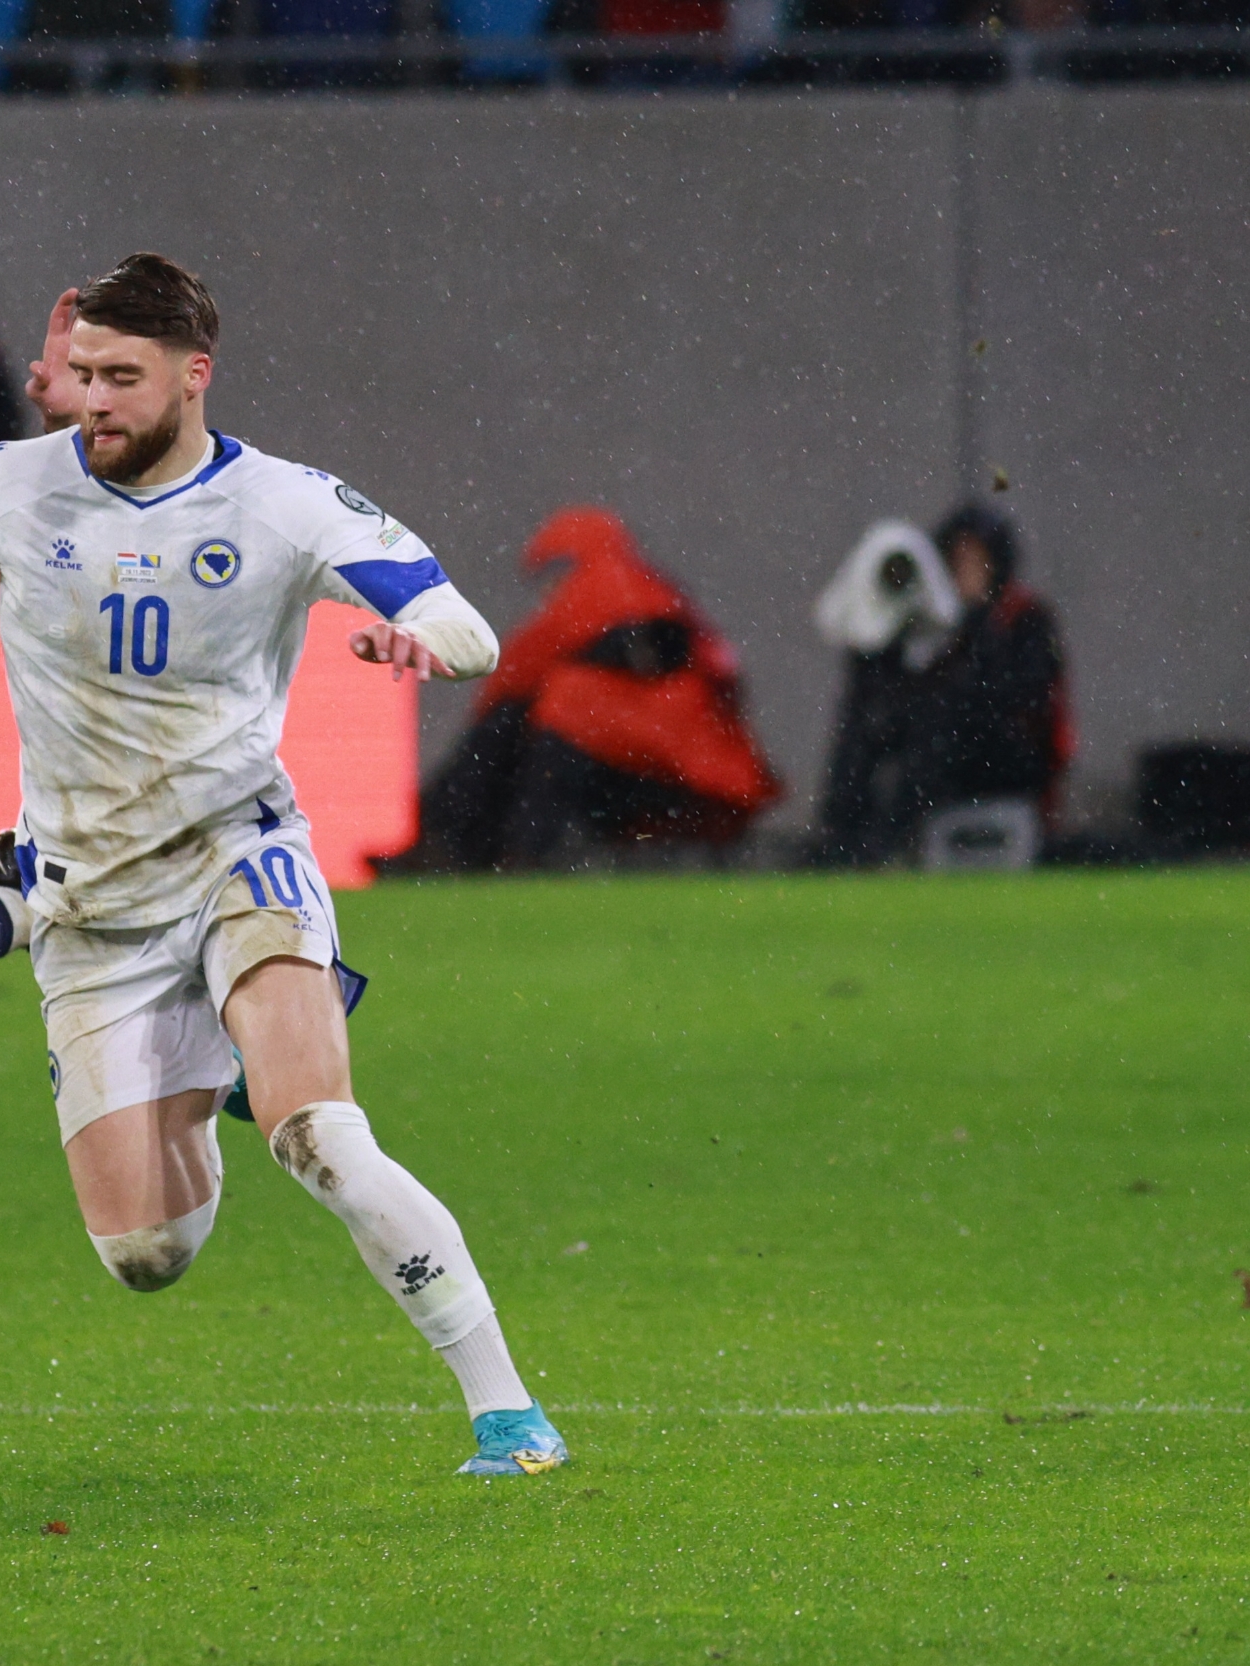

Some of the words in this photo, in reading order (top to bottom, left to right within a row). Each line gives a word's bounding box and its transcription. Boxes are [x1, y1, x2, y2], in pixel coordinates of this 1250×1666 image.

[45, 560, 83, 571] KELME
[99, 592, 170, 677] 10
[229, 846, 303, 908] 10
